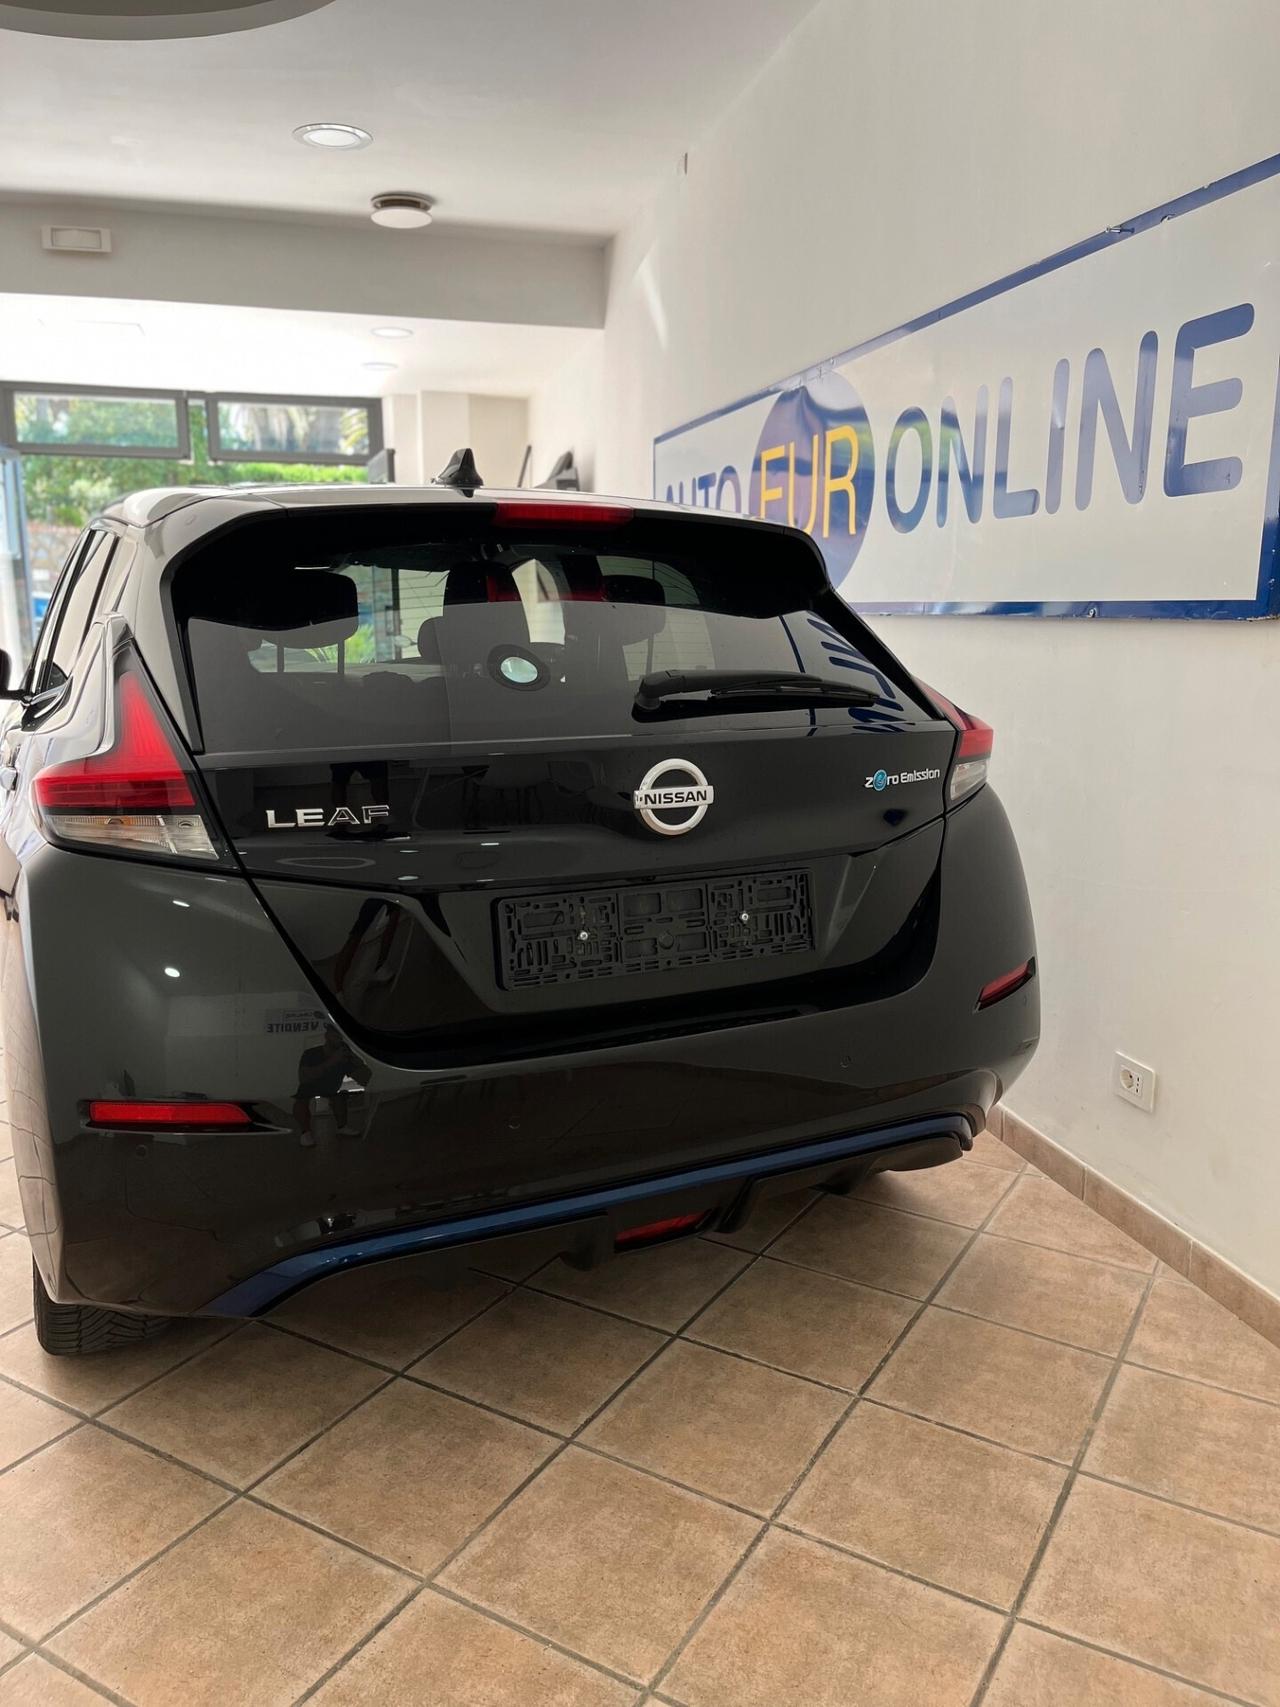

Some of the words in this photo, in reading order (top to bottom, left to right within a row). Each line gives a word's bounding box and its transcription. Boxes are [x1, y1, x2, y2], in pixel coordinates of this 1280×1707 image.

[666, 465, 742, 513] TO
[886, 303, 1255, 534] ONLINE
[900, 766, 940, 783] Emission
[644, 790, 707, 805] NISSAN
[266, 805, 390, 828] LEAF
